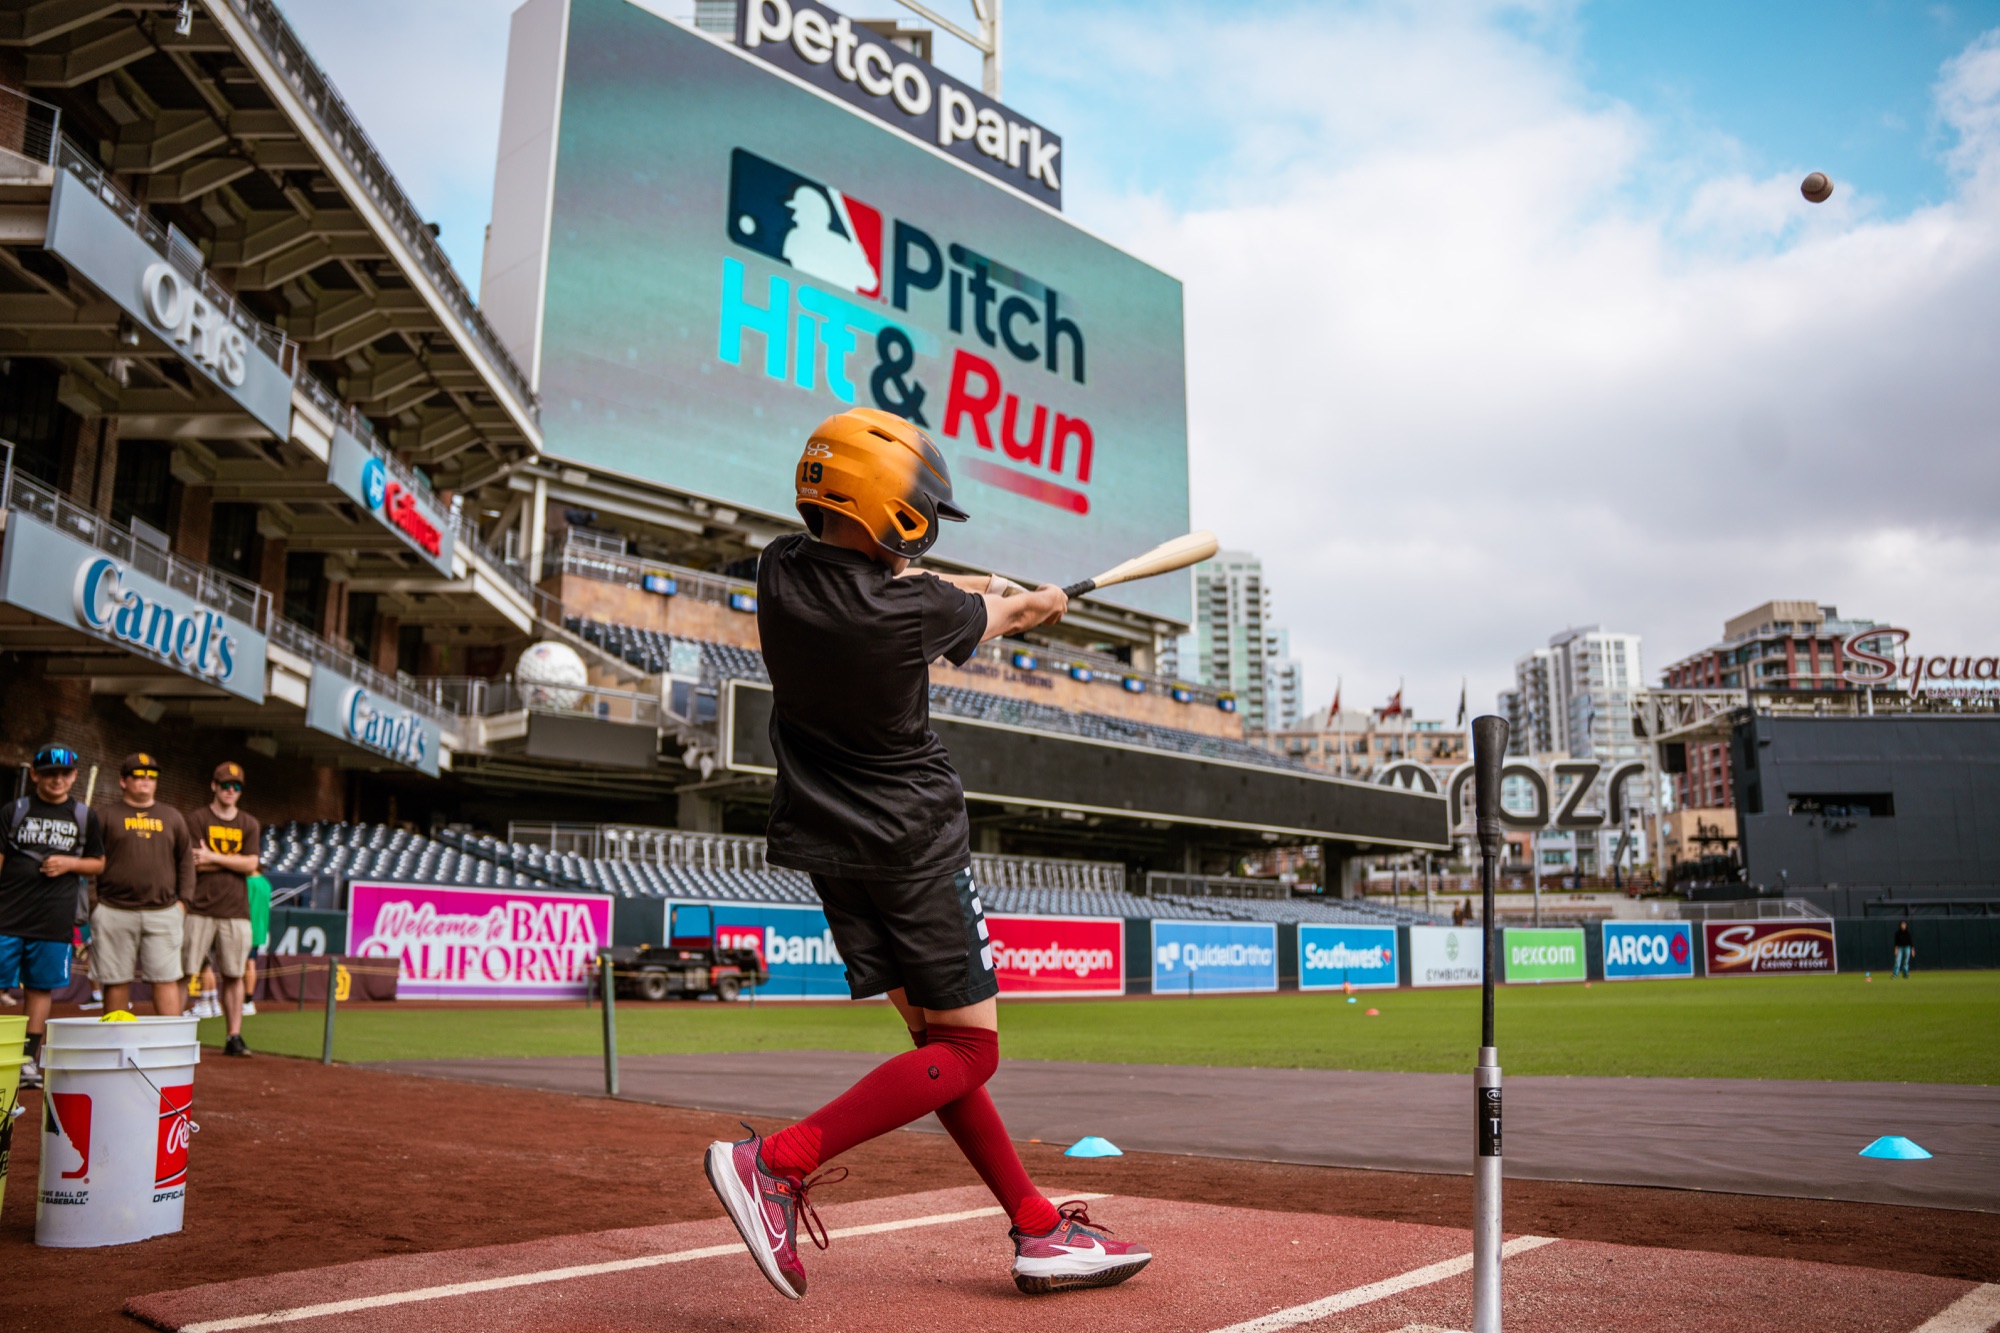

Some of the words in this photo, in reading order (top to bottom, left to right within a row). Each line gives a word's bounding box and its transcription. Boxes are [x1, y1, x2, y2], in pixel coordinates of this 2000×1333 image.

[745, 0, 932, 115] petco
[937, 83, 1061, 190] park
[892, 218, 1087, 385] Pitch
[142, 262, 247, 388] ORIS
[718, 256, 857, 404] Hit
[869, 326, 931, 430] &
[942, 348, 1095, 485] Run
[801, 461, 823, 484] 19
[73, 556, 238, 683] Canel's
[1925, 687, 1980, 700] CASINO
[342, 685, 428, 764] Canel's
[42, 818, 78, 837] Pitch
[48, 832, 77, 849] Run
[379, 904, 482, 938] Welcome
[485, 910, 509, 942] to
[511, 907, 597, 946] BAJA
[990, 940, 1114, 978] Snapdragon
[1182, 943, 1273, 971] QuidelOrtho
[1305, 941, 1384, 970] Southwest
[1607, 934, 1669, 966] ARCO
[1715, 926, 1824, 972] Sycuan
[1760, 959, 1793, 970] CASINO
[1799, 958, 1829, 969] RESORT
[76, 1190, 89, 1198] OF
